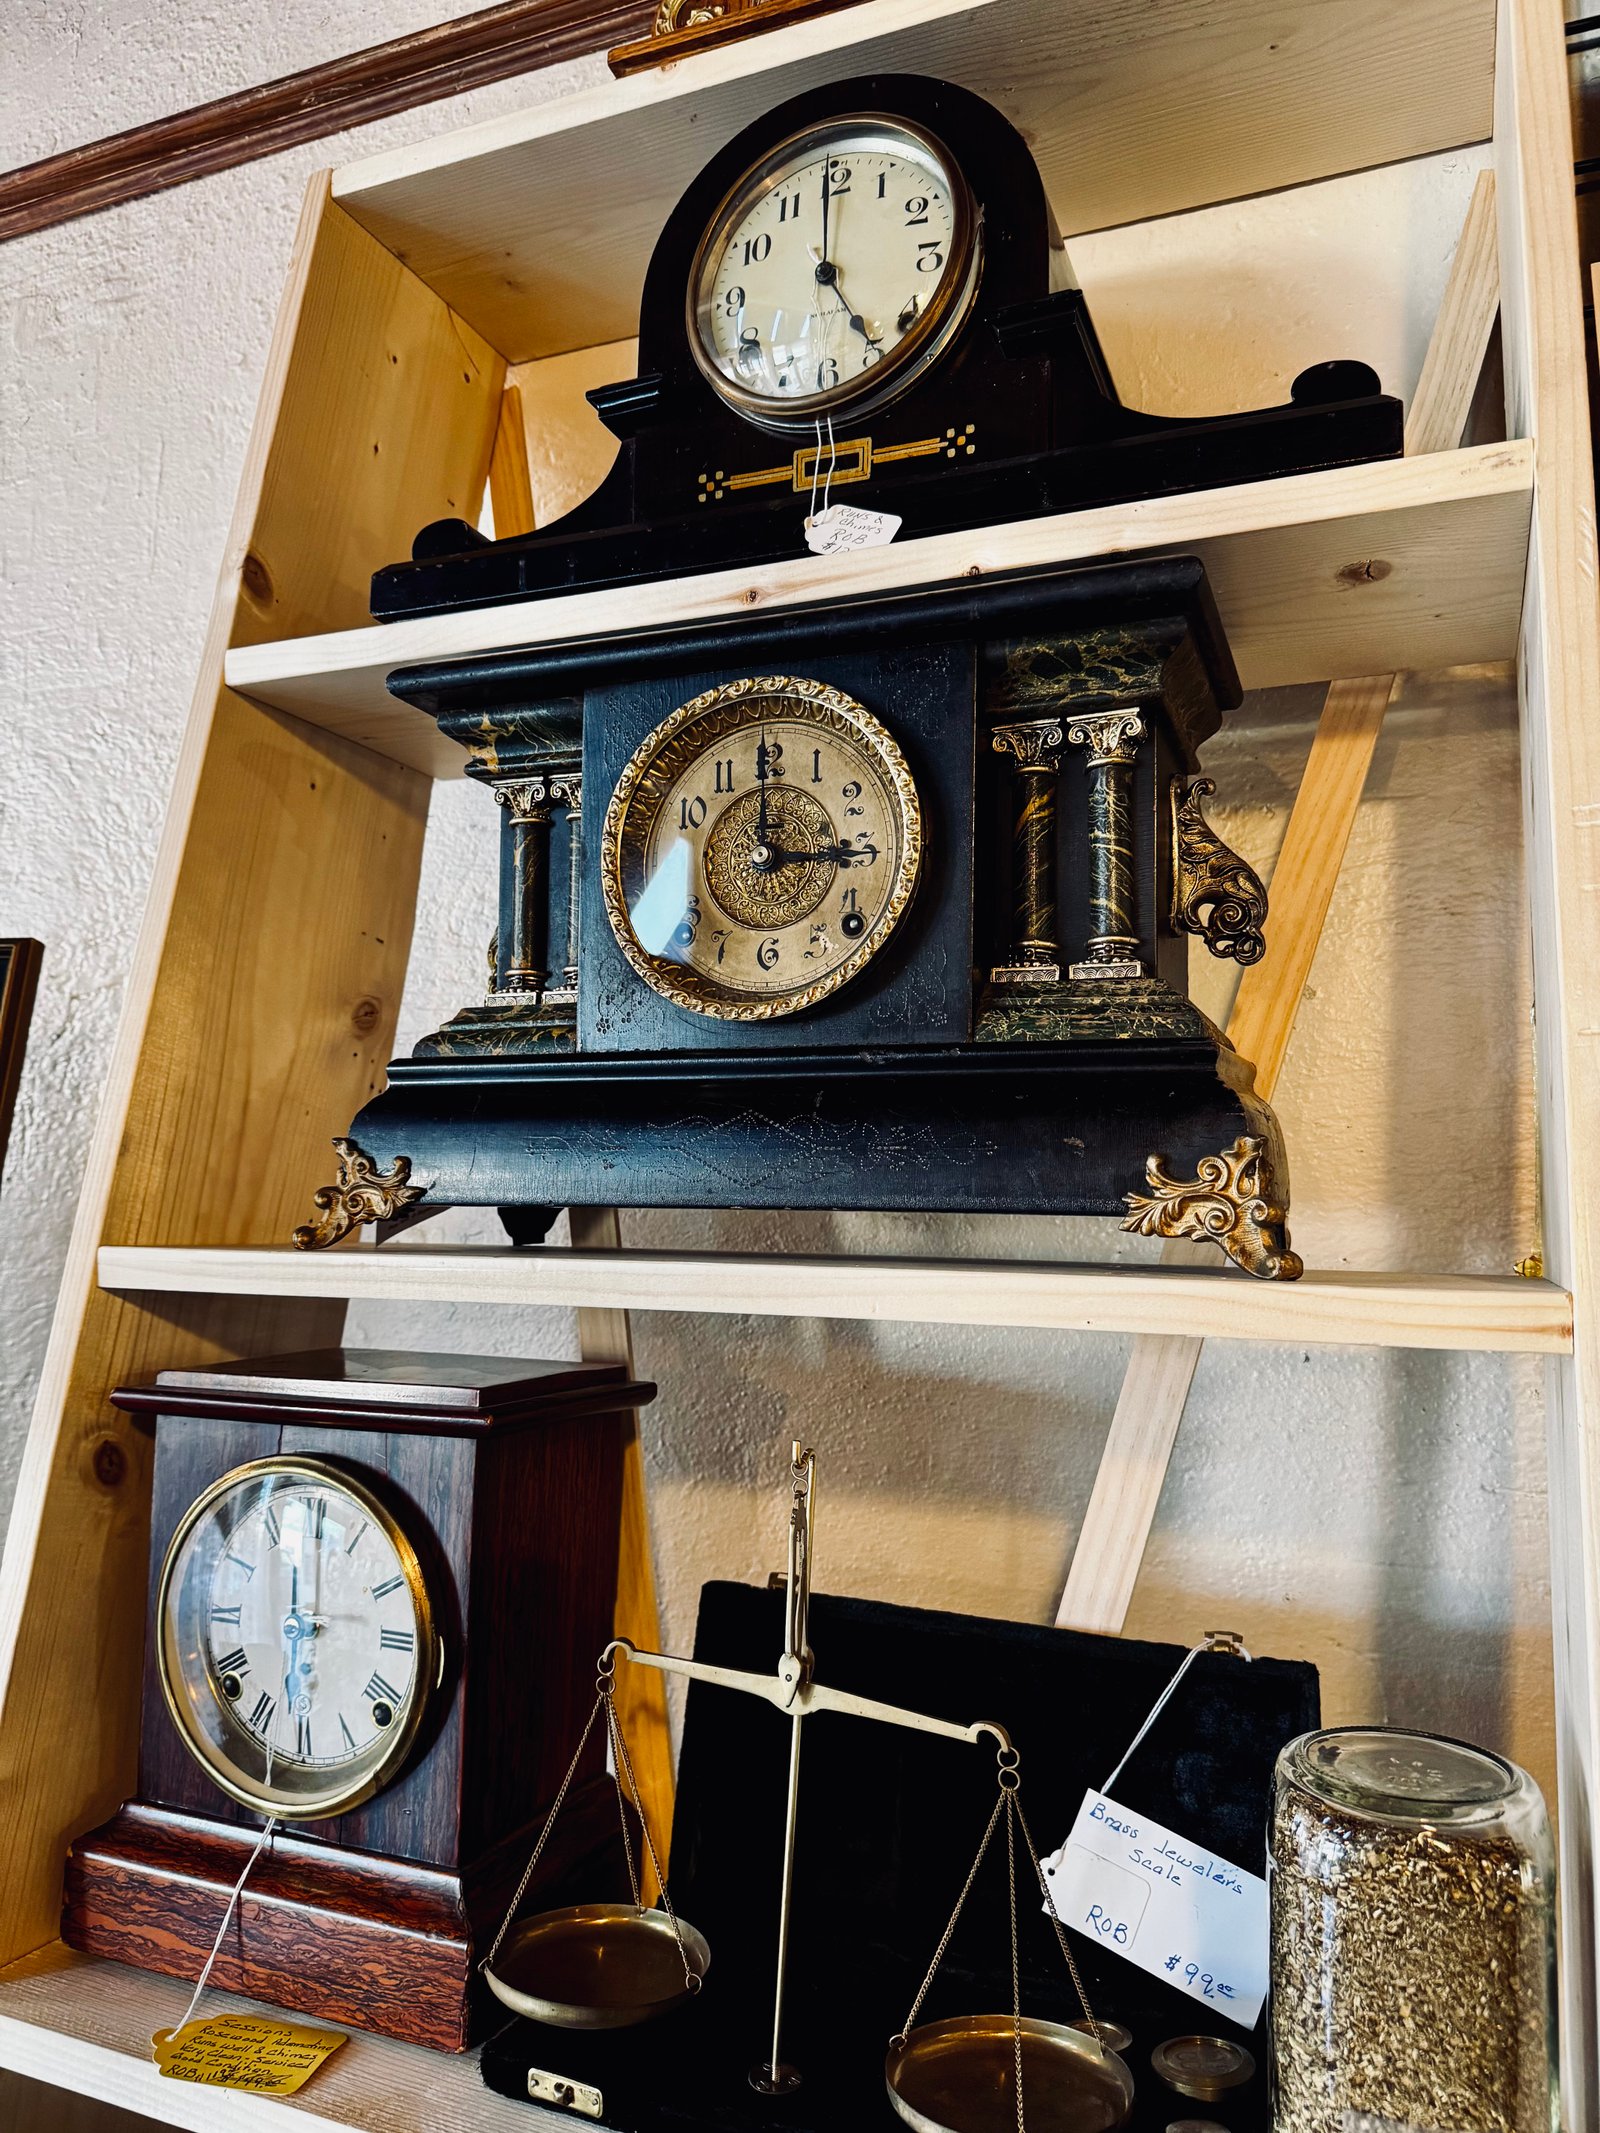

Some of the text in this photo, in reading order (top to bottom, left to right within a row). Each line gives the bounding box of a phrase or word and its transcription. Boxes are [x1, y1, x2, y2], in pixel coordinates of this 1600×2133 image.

[820, 168, 852, 199] 12
[876, 172, 888, 199] 1
[779, 192, 800, 223] 11
[904, 196, 929, 226] 2
[743, 233, 772, 267] 10
[916, 241, 943, 272] 3
[725, 286, 746, 317] 9
[863, 337, 886, 368] 5
[817, 358, 839, 391] 6
[874, 515, 884, 525] &
[830, 528, 868, 545] ROB
[714, 758, 735, 793] 11
[755, 742, 785, 780] 12
[811, 748, 823, 784] 1
[679, 795, 707, 830] 10
[842, 781, 865, 817] 2
[852, 832, 879, 868] 3
[711, 930, 733, 964] 7
[757, 937, 780, 972] 6
[803, 923, 828, 958] 5
[1089, 1802, 1243, 1895] Brass Jewelers
[1128, 1848, 1182, 1887] Scale
[1085, 1904, 1129, 1945] ROB
[199, 2025, 269, 2044] Rosewood
[218, 2019, 293, 2037] Sessions
[170, 2052, 205, 2064] Good
[179, 2042, 206, 2057] Very
[207, 2049, 242, 2061] Clean
[252, 2056, 315, 2069] Serviced
[188, 2035, 218, 2048] Runs
[254, 2046, 266, 2054] &
[166, 2063, 198, 2079] ROB
